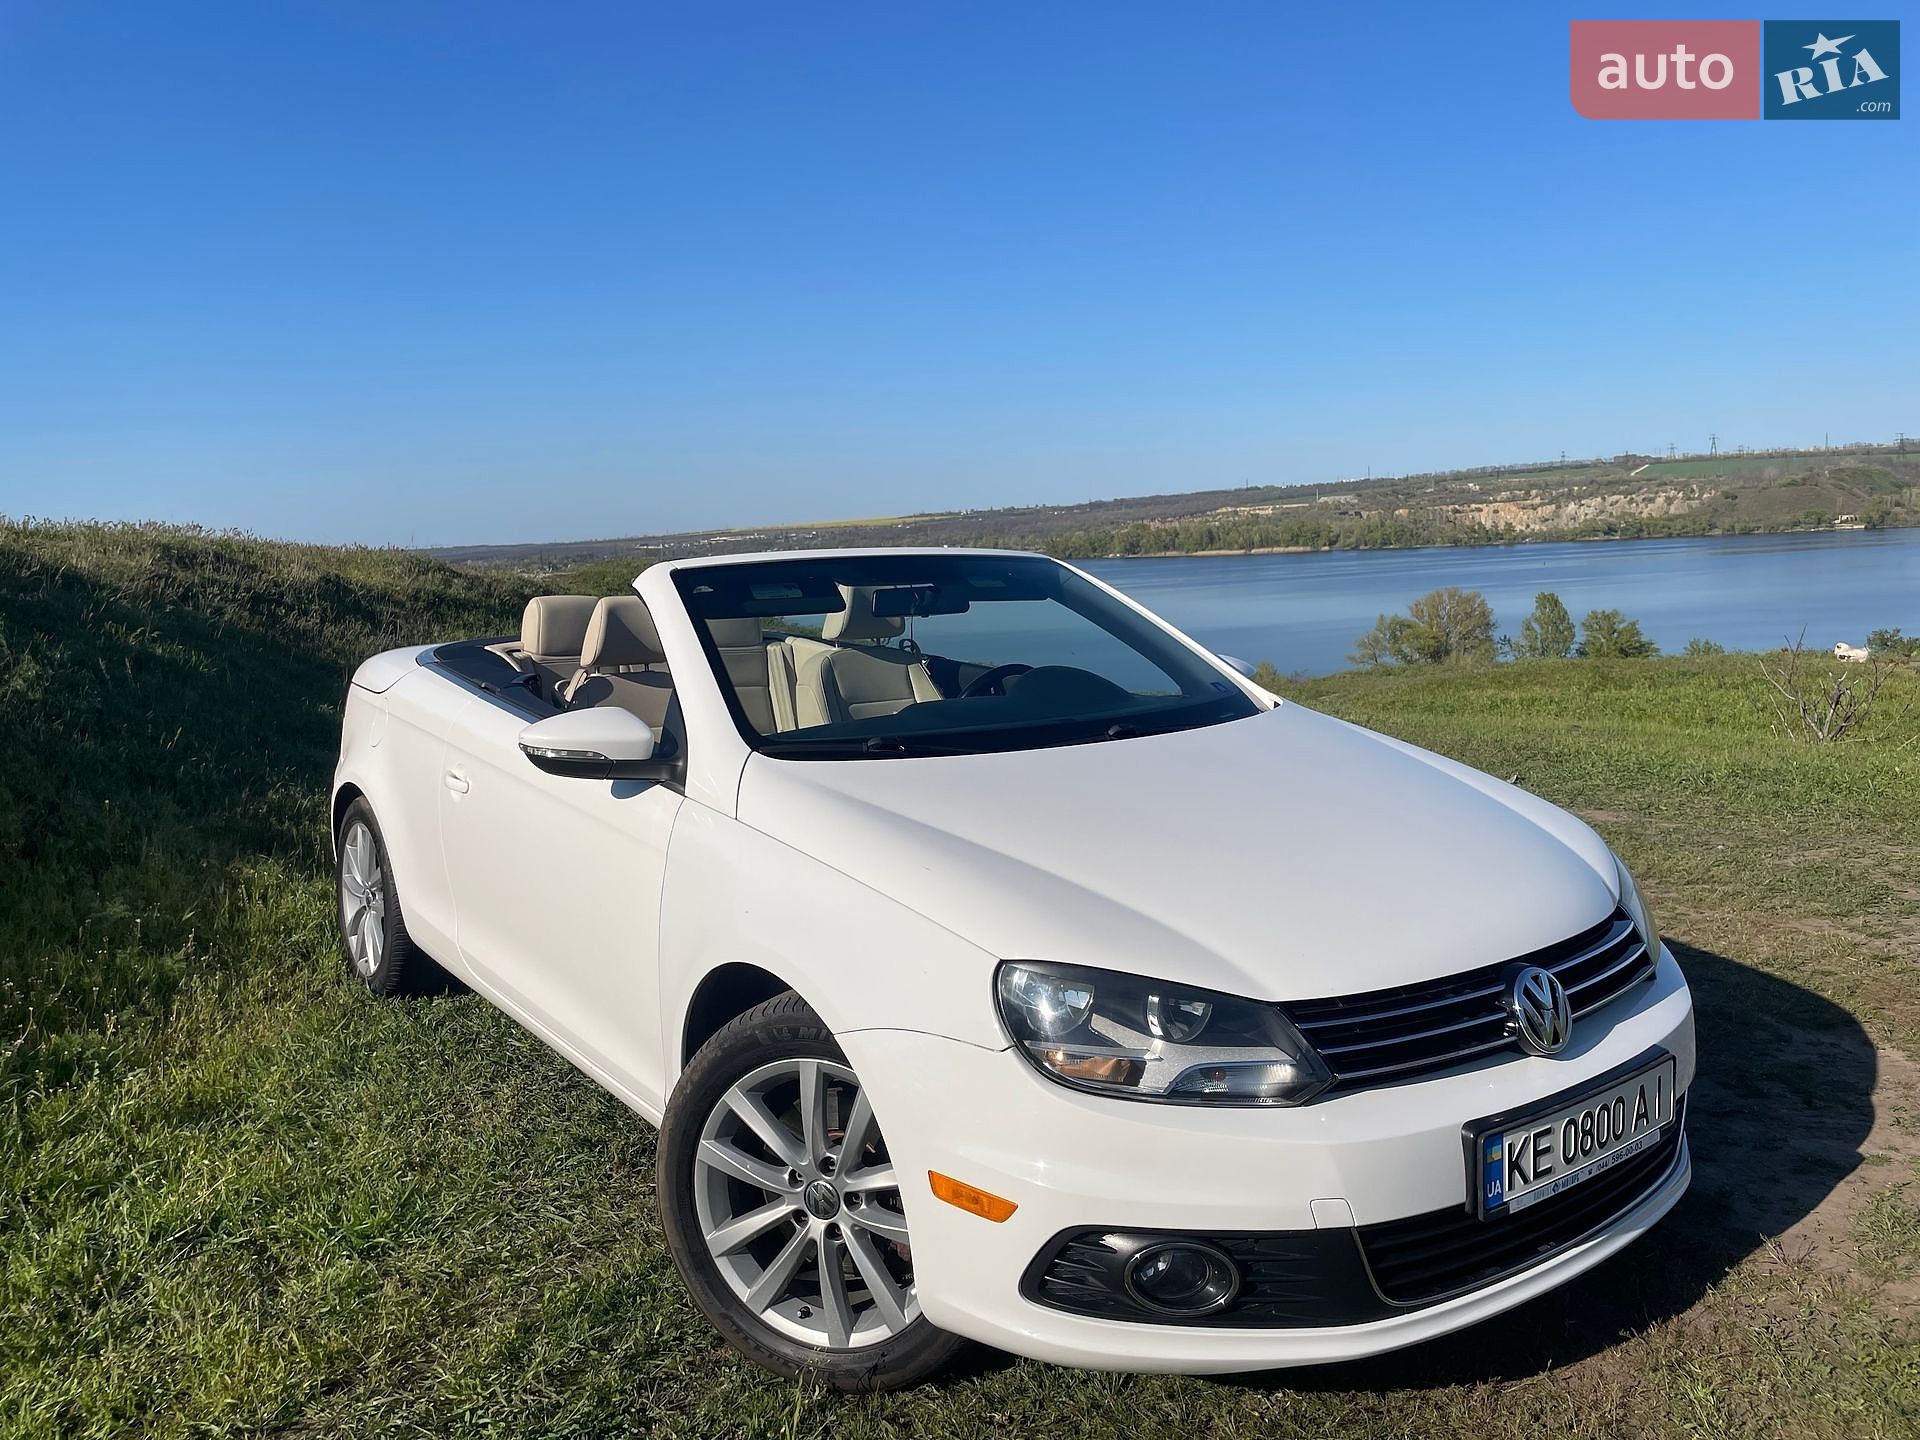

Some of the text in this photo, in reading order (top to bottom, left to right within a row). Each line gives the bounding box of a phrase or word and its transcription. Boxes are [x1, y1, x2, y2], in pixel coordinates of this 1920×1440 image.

[1506, 1125, 1554, 1193] KE
[1561, 1096, 1626, 1166] 0800
[1486, 1179, 1503, 1198] UA
